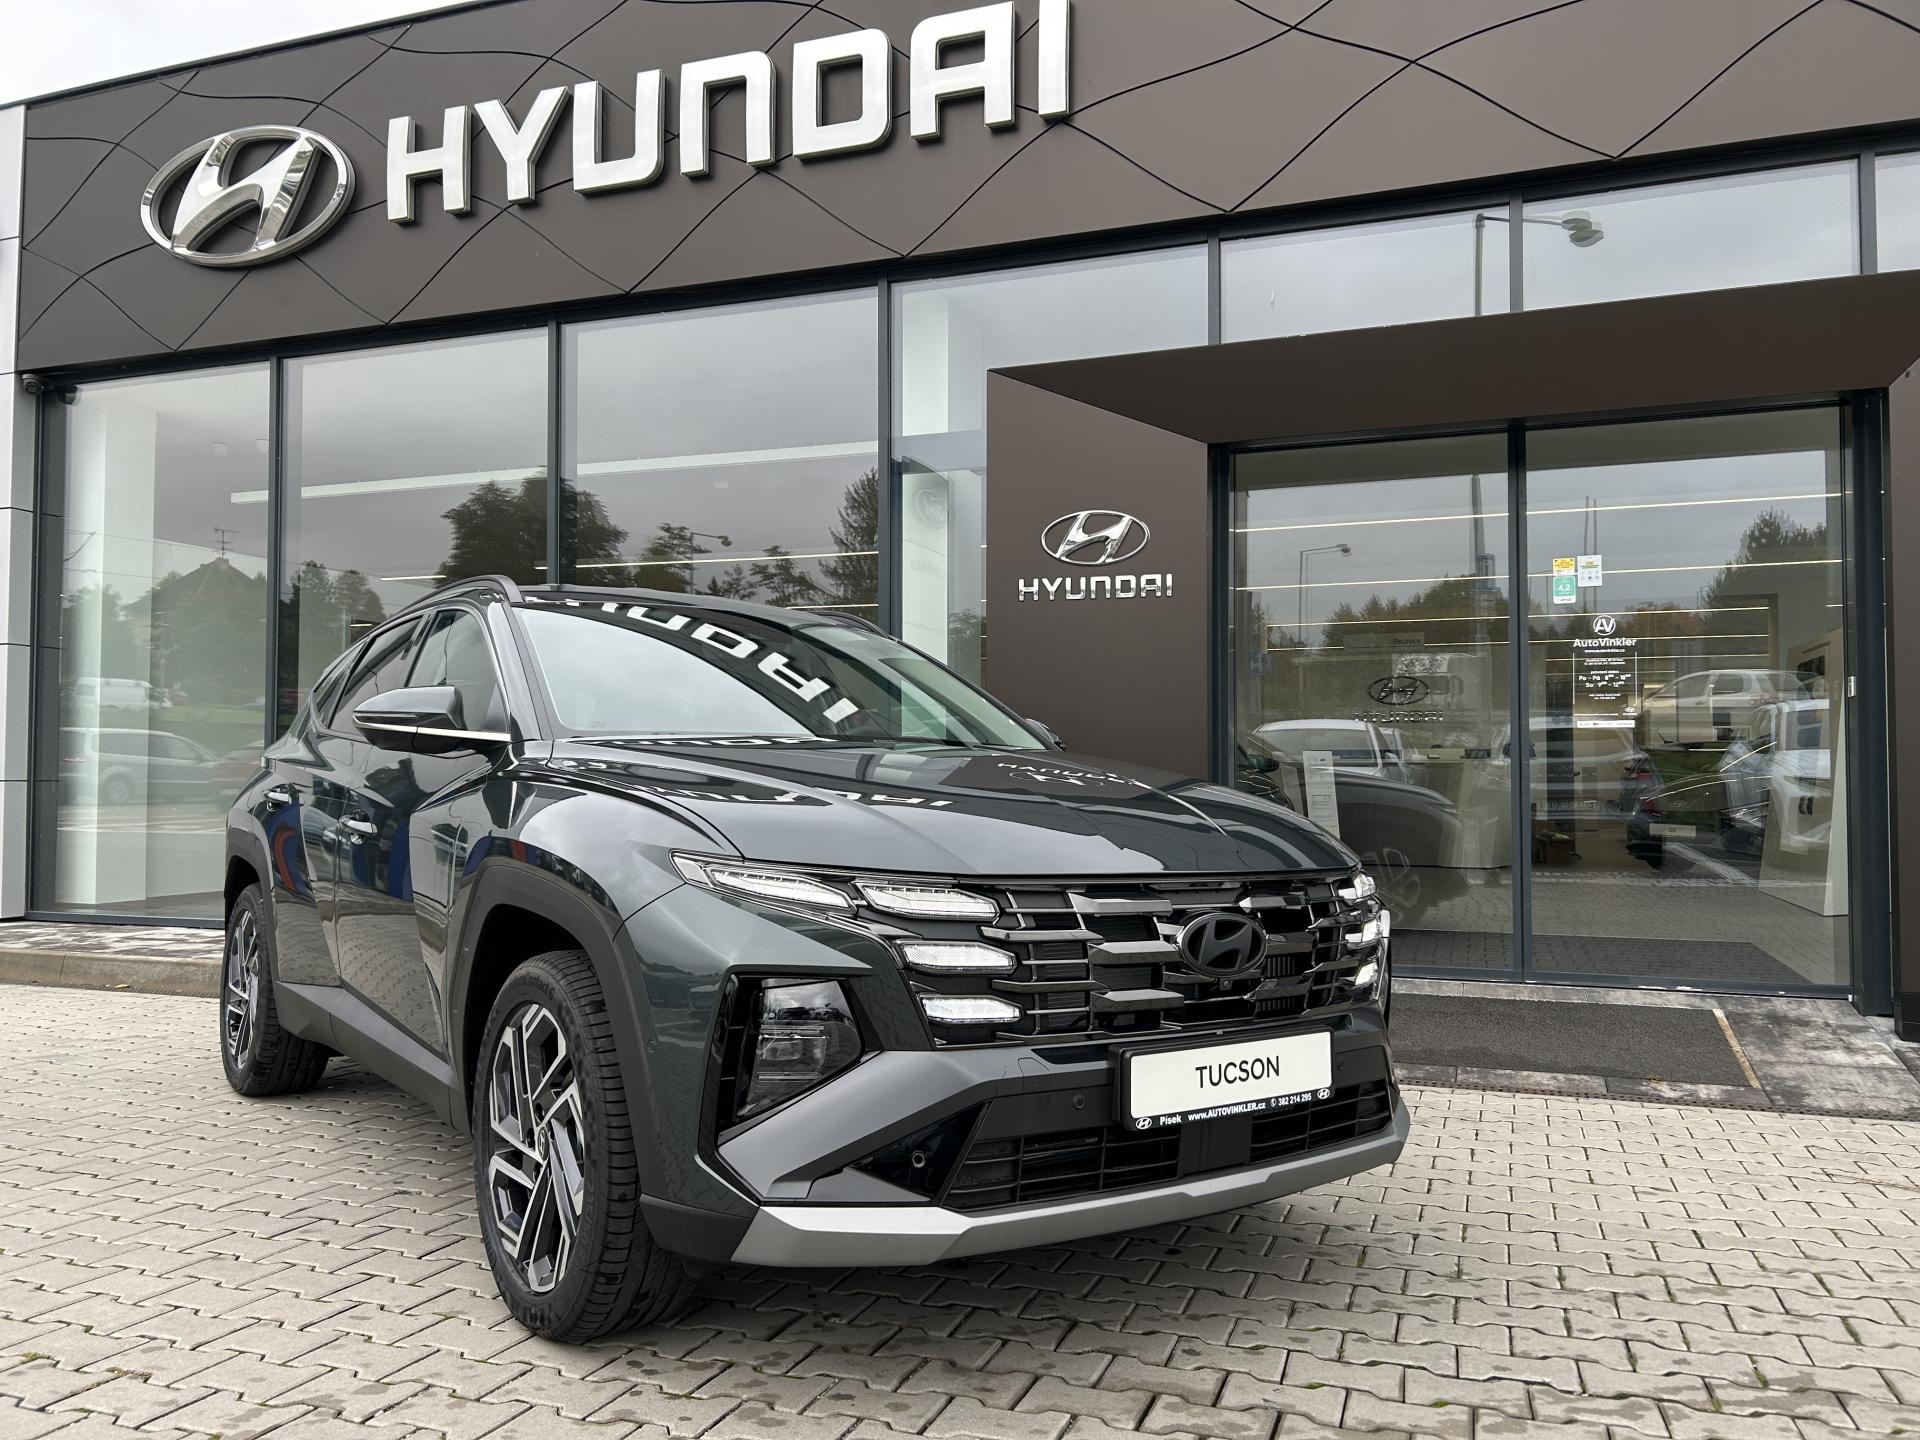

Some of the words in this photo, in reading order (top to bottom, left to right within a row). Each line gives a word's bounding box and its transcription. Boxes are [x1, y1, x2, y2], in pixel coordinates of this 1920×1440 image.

[386, 0, 1072, 223] HYUNDAI
[1018, 573, 1174, 602] HYUNDAI
[1573, 638, 1637, 647] AutoVinkler
[1195, 1055, 1280, 1089] TUCSON
[1188, 1102, 1266, 1121] www.AUTOVINKLER.cz
[1278, 1096, 1289, 1106] 382
[1289, 1094, 1300, 1105] 214
[1301, 1092, 1312, 1103] 295
